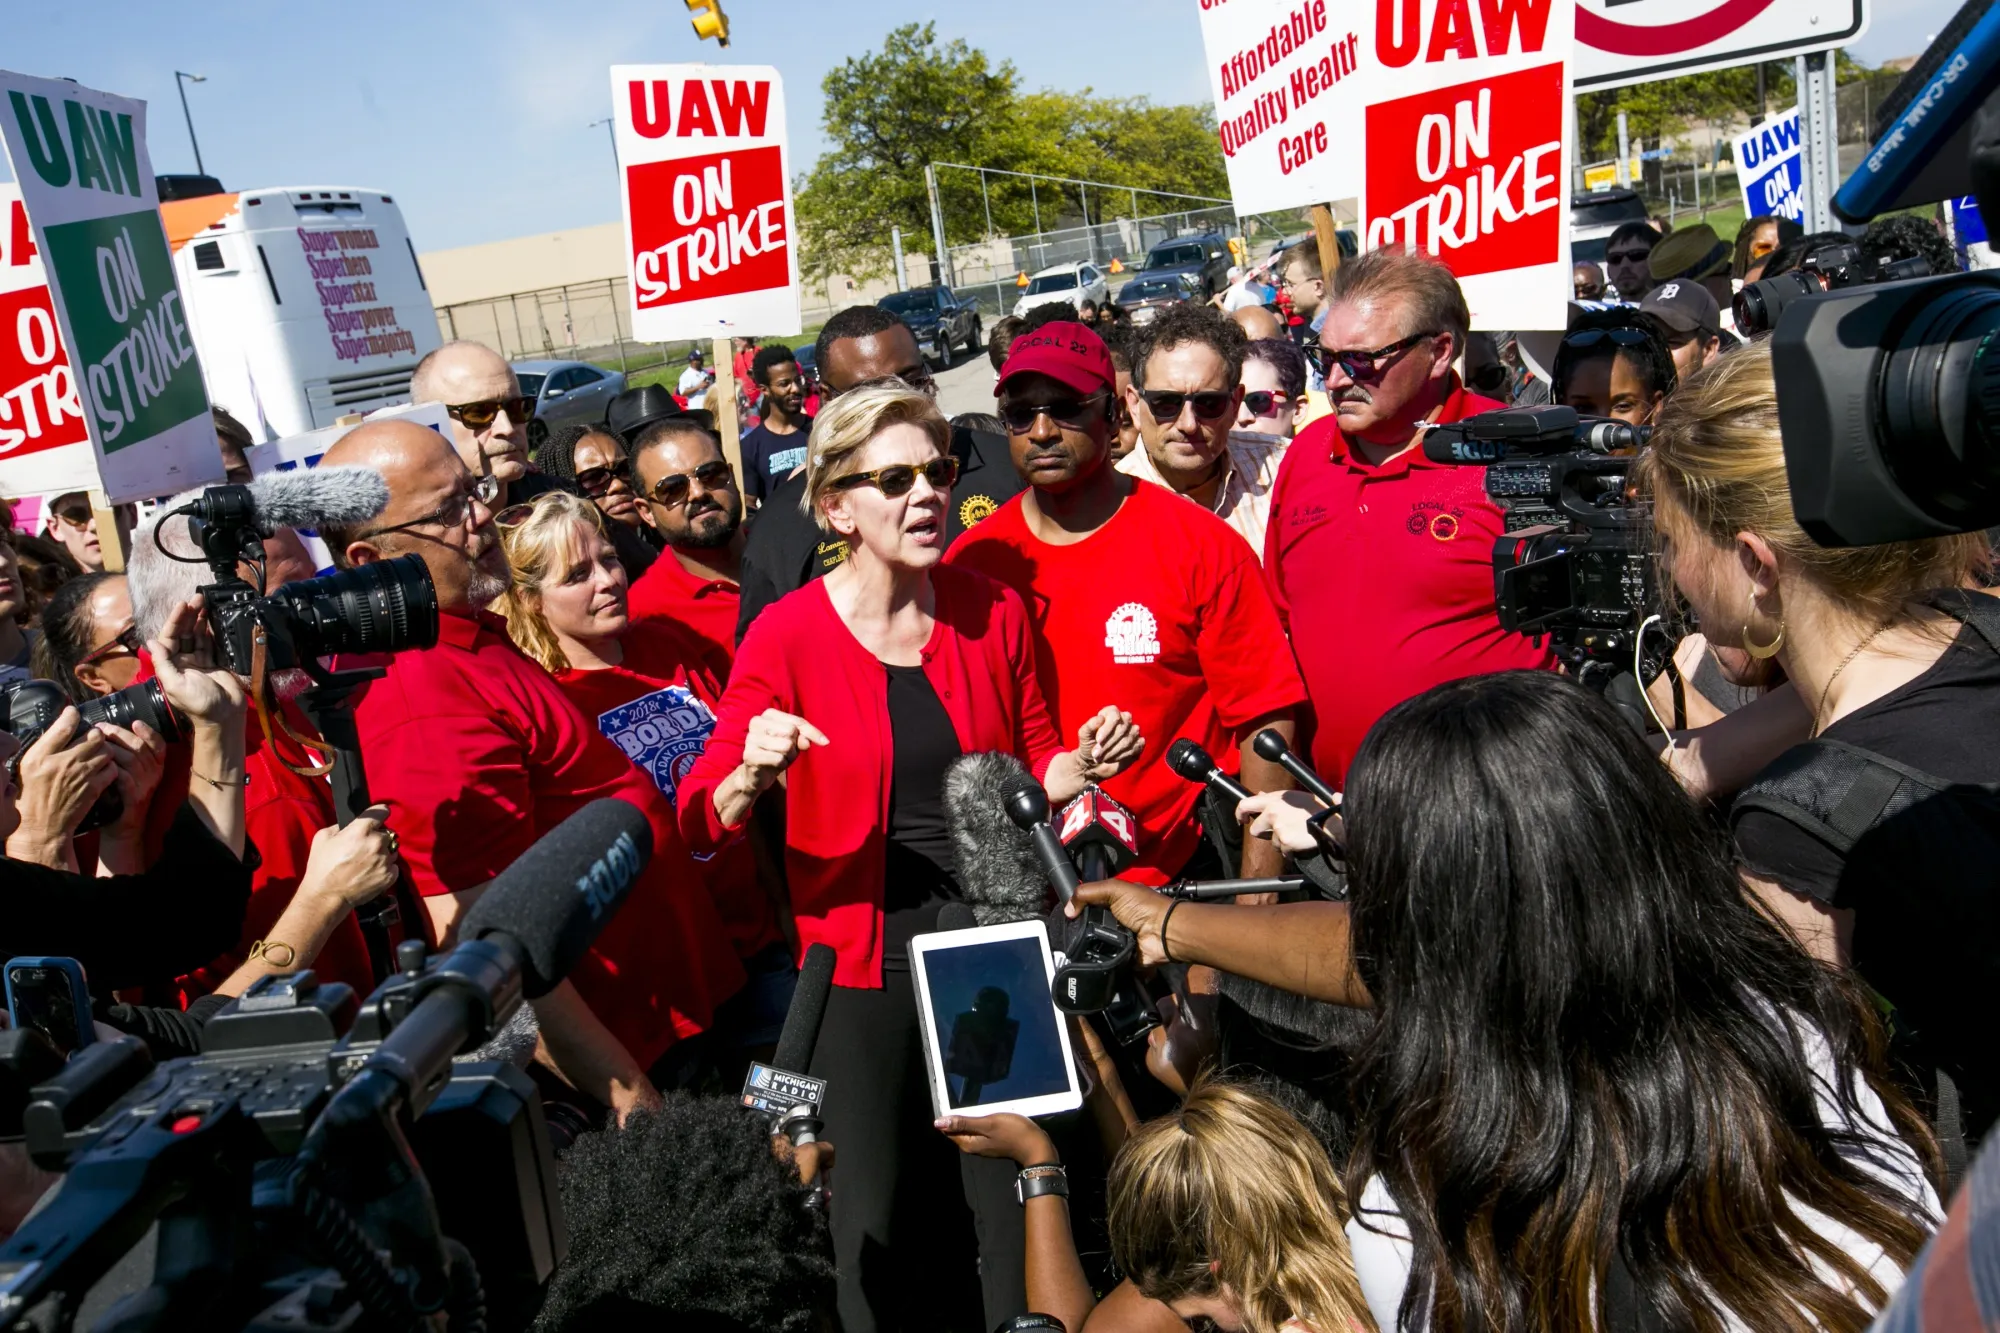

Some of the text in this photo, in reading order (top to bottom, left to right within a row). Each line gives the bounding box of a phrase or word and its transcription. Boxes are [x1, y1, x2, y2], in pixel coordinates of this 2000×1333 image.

[1221, 0, 1327, 101] Affordable
[1375, 0, 1552, 68] UAW
[628, 80, 770, 139] UAW
[1220, 85, 1288, 158] Quality
[8, 89, 141, 198] UAW
[1278, 121, 1328, 176] Care
[1416, 88, 1491, 183] ON
[1741, 114, 1800, 169] UAW
[673, 158, 733, 226] ON
[1764, 163, 1791, 208] ON
[297, 227, 380, 257] Superwoman
[635, 200, 787, 303] STRIKE
[96, 226, 145, 323] ON
[306, 252, 372, 283] Superhero
[315, 280, 378, 310] Superstar
[17, 307, 69, 366] O
[324, 306, 397, 336] Superpower
[88, 289, 194, 442] STRIKE
[332, 327, 416, 364] Supermajority
[1070, 340, 1088, 356] 22
[1411, 501, 1447, 512] LOCAL
[657, 748, 674, 768] DAY
[672, 741, 697, 755] FOR
[1058, 790, 1090, 816] OCAL
[1060, 800, 1090, 840] 4
[1100, 811, 1133, 842] 4
[771, 1081, 817, 1100] RADIO
[773, 1074, 819, 1092] MICHIGAN
